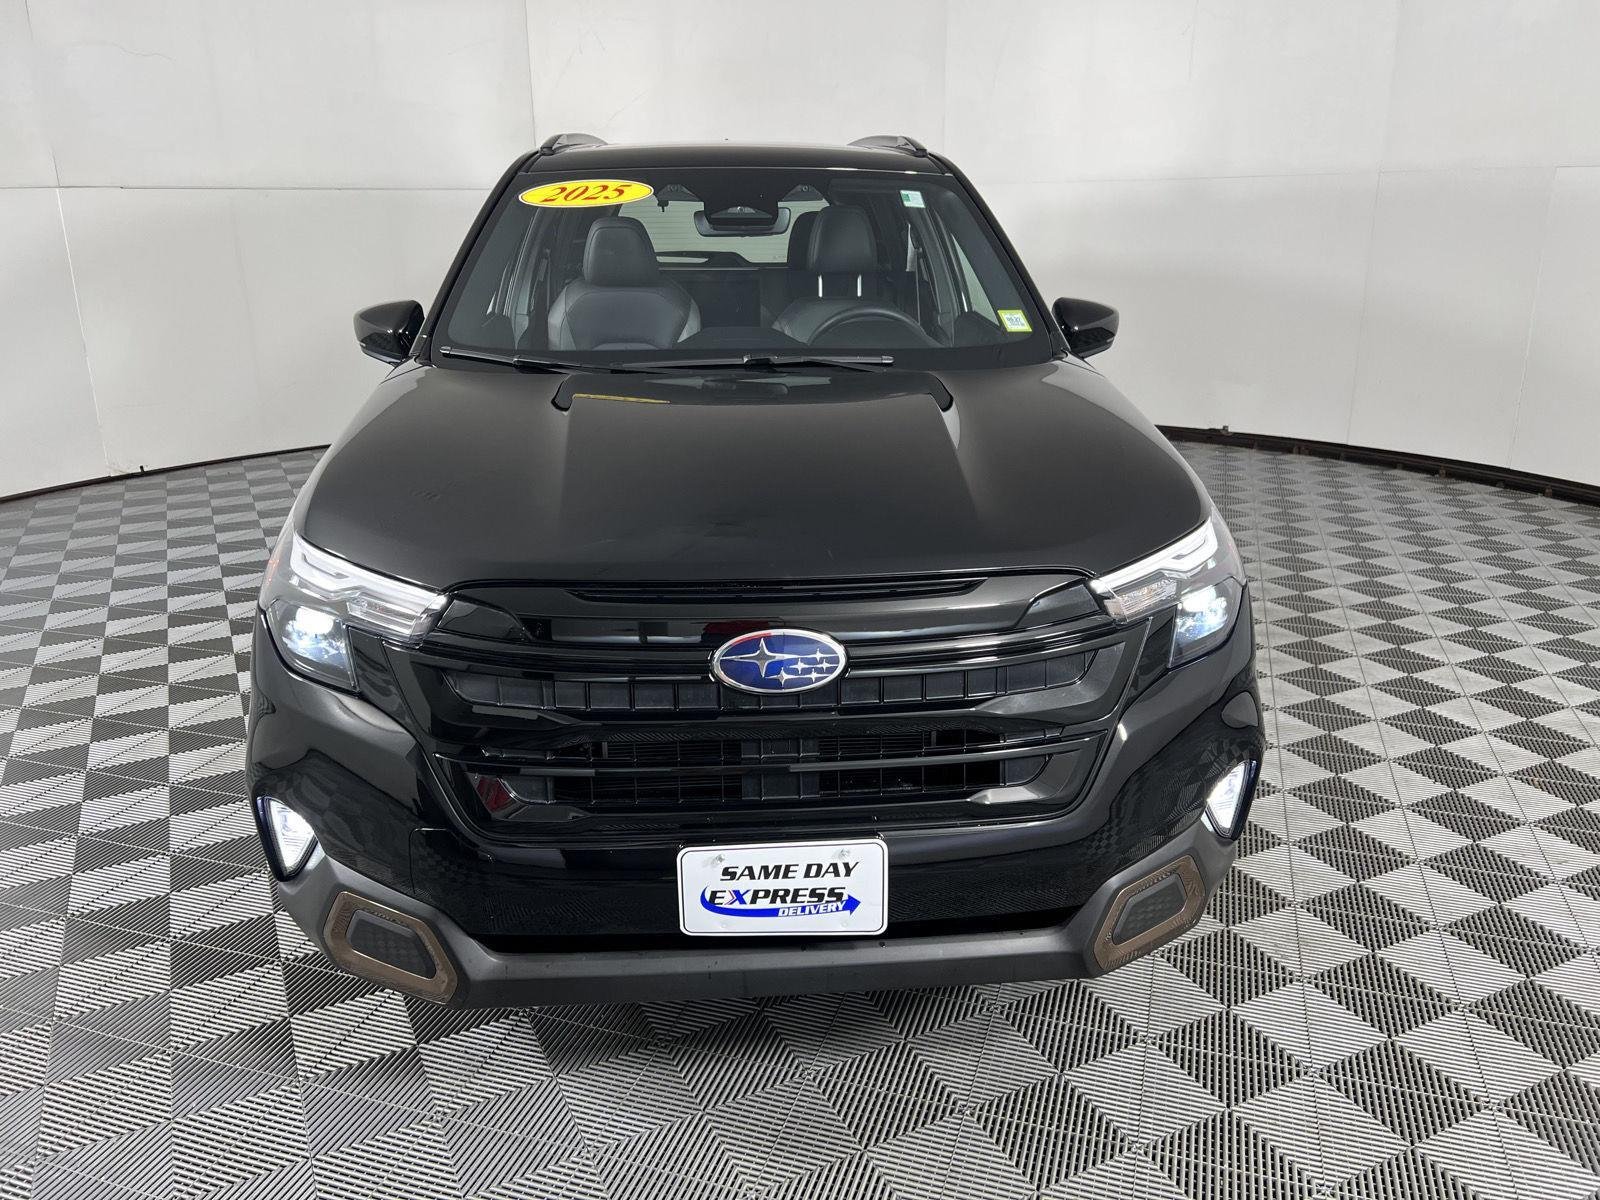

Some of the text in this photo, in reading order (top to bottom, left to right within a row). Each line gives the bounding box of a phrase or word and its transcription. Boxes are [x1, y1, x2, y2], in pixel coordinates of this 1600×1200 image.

[540, 184, 632, 202] 2025
[720, 861, 860, 882] SAME DAY
[708, 886, 846, 906] EXPRESS
[778, 901, 846, 918] DELIVERY
